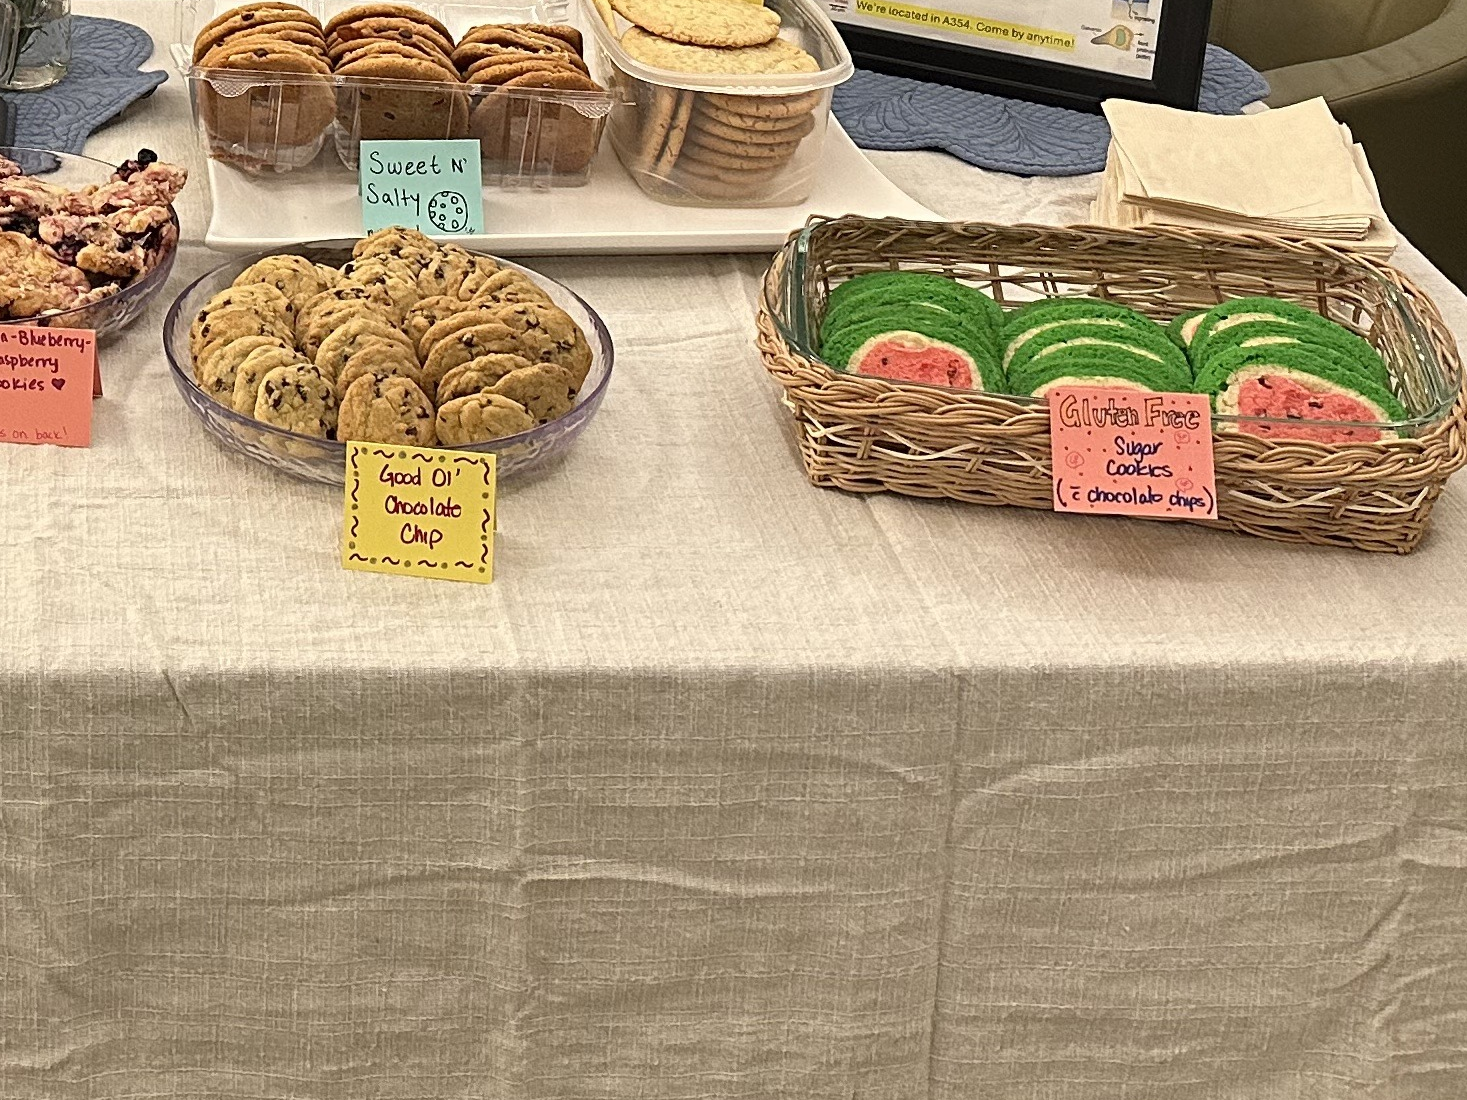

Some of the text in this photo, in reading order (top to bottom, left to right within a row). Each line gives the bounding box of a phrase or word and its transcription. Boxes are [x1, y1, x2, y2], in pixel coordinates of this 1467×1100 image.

[856, 0, 886, 14] We're
[888, 6, 928, 21] located
[930, 13, 940, 23] in
[942, 16, 973, 30] A354.
[976, 22, 1009, 36] Come
[1011, 28, 1024, 40] by
[1026, 32, 1074, 48] anytime!
[370, 151, 441, 175] Sweet
[366, 182, 420, 217] Salty
[1059, 394, 1201, 430] Gluten Free
[12, 430, 28, 439] on
[35, 426, 67, 440] back!
[1114, 435, 1163, 463] Sugar
[379, 463, 422, 488] Good
[1106, 459, 1174, 478] Cookies
[385, 494, 462, 518] Chocolate
[400, 522, 444, 550] Chip
